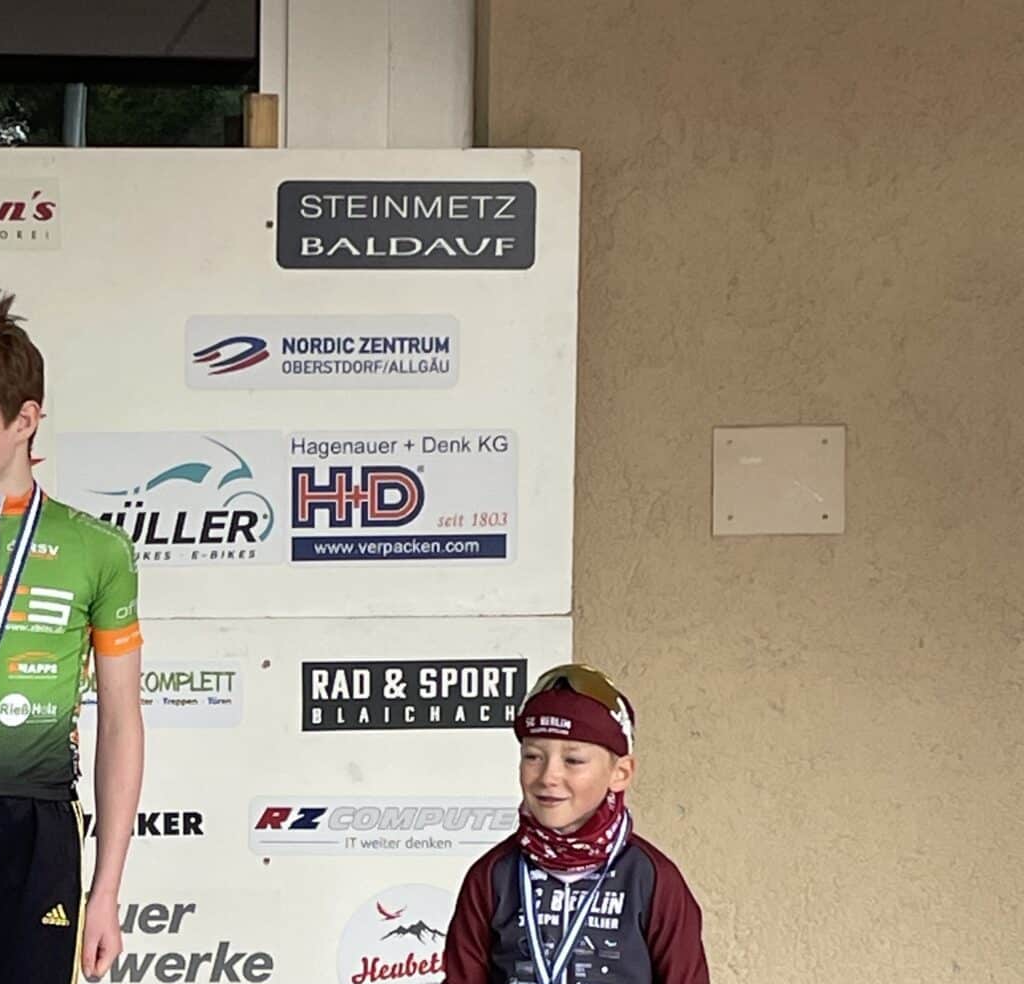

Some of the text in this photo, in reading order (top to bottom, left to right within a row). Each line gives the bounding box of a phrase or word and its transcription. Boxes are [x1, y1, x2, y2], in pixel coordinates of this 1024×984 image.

[300, 195, 517, 219] STEINMETZ
[300, 236, 516, 256] BALDAUF
[282, 337, 450, 354] NORDIC ZENTRUM
[282, 357, 450, 374] OBERSTDORF/ALLGÄU
[291, 436, 509, 459] Hagenauer + Denk KG
[437, 512, 508, 527] seit 1803
[191, 550, 256, 560] E-BIKES
[314, 539, 480, 557] www.verpacken.com
[140, 671, 236, 693] OMPLETT
[311, 667, 517, 700] RAD & SPORT
[311, 705, 515, 724] BLAICHACH
[254, 807, 328, 830] RZ
[345, 836, 452, 849] IT weiter denken
[110, 941, 274, 983] werke
